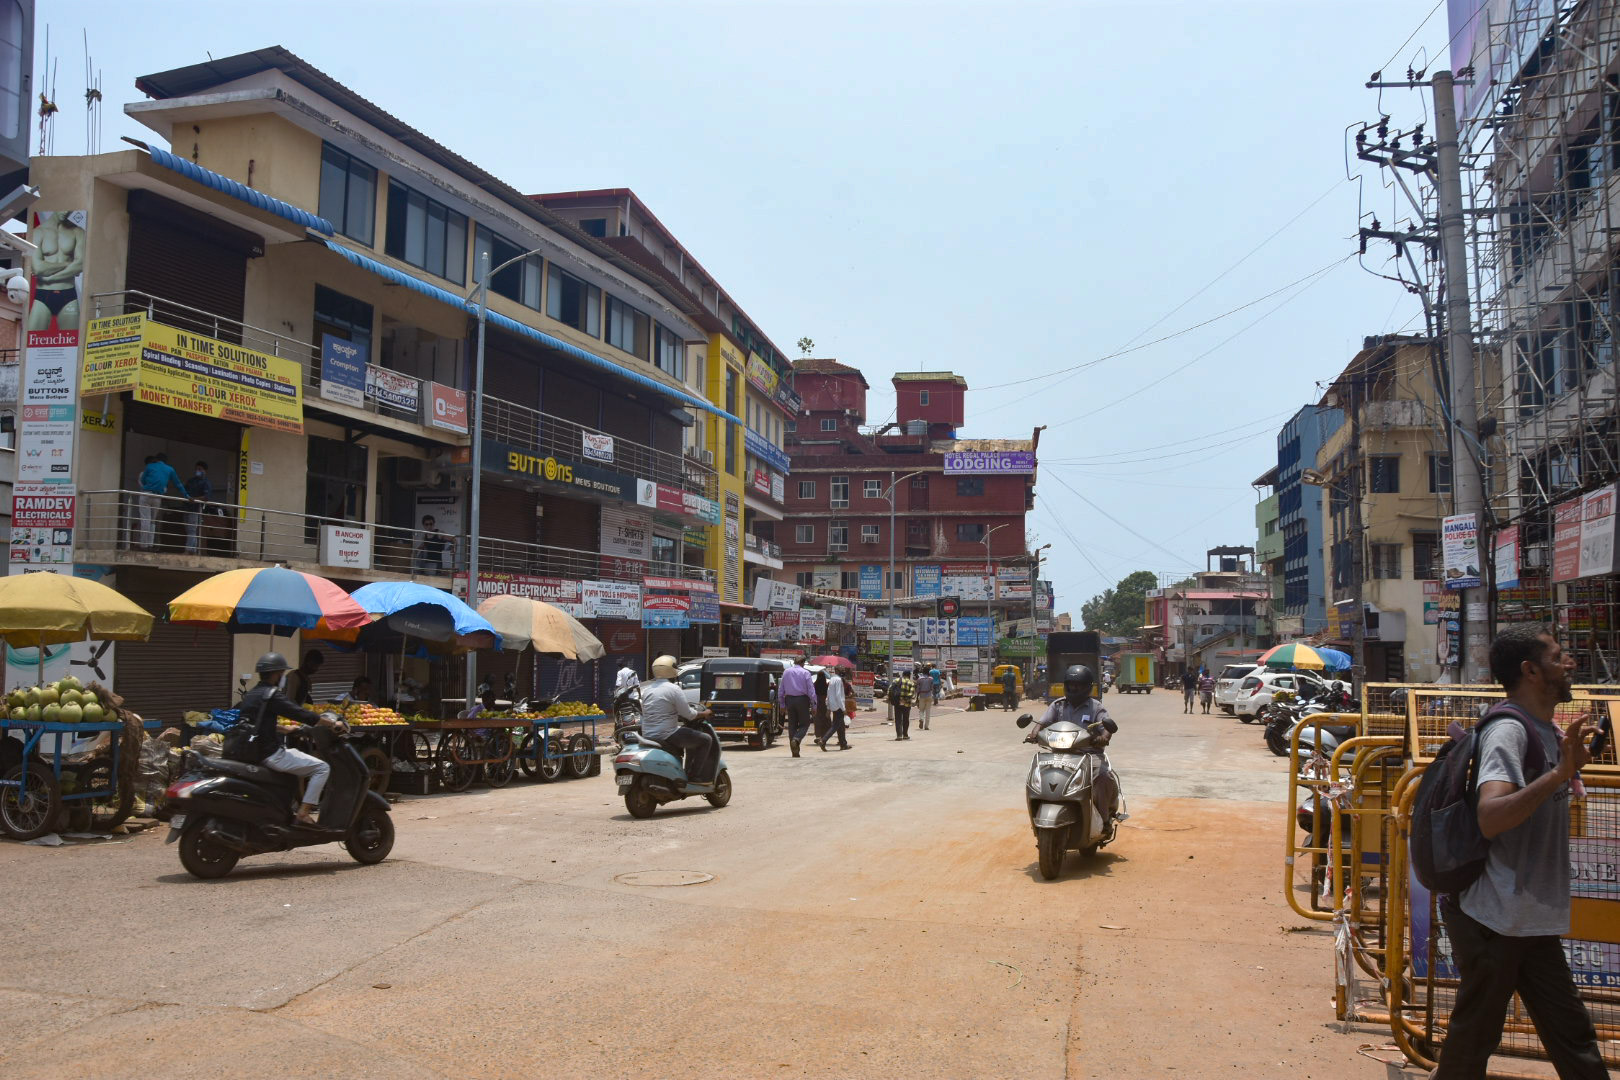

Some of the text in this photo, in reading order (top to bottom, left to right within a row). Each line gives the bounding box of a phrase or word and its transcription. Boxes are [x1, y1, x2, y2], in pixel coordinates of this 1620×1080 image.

[29, 333, 76, 345] Frenchie
[143, 349, 160, 362] Spiral
[176, 334, 268, 370] IN TIME SOLUTIONS
[85, 358, 138, 372] COLOUR XEROX
[330, 358, 360, 373] Crompton
[140, 388, 213, 414] MONEY TRANSFER
[192, 384, 256, 408] COLOUR XEROX
[944, 458, 1012, 470] LODGING
[575, 477, 591, 488] MENS
[593, 481, 620, 494] BOUTIQUE
[16, 498, 72, 510] RAMDEV
[16, 511, 72, 520] ELECTRICALS
[341, 530, 364, 540] ANCHOR
[1444, 532, 1466, 540] POLICE
[477, 581, 508, 594] AMDEV
[510, 583, 560, 598] ELECTRICALS
